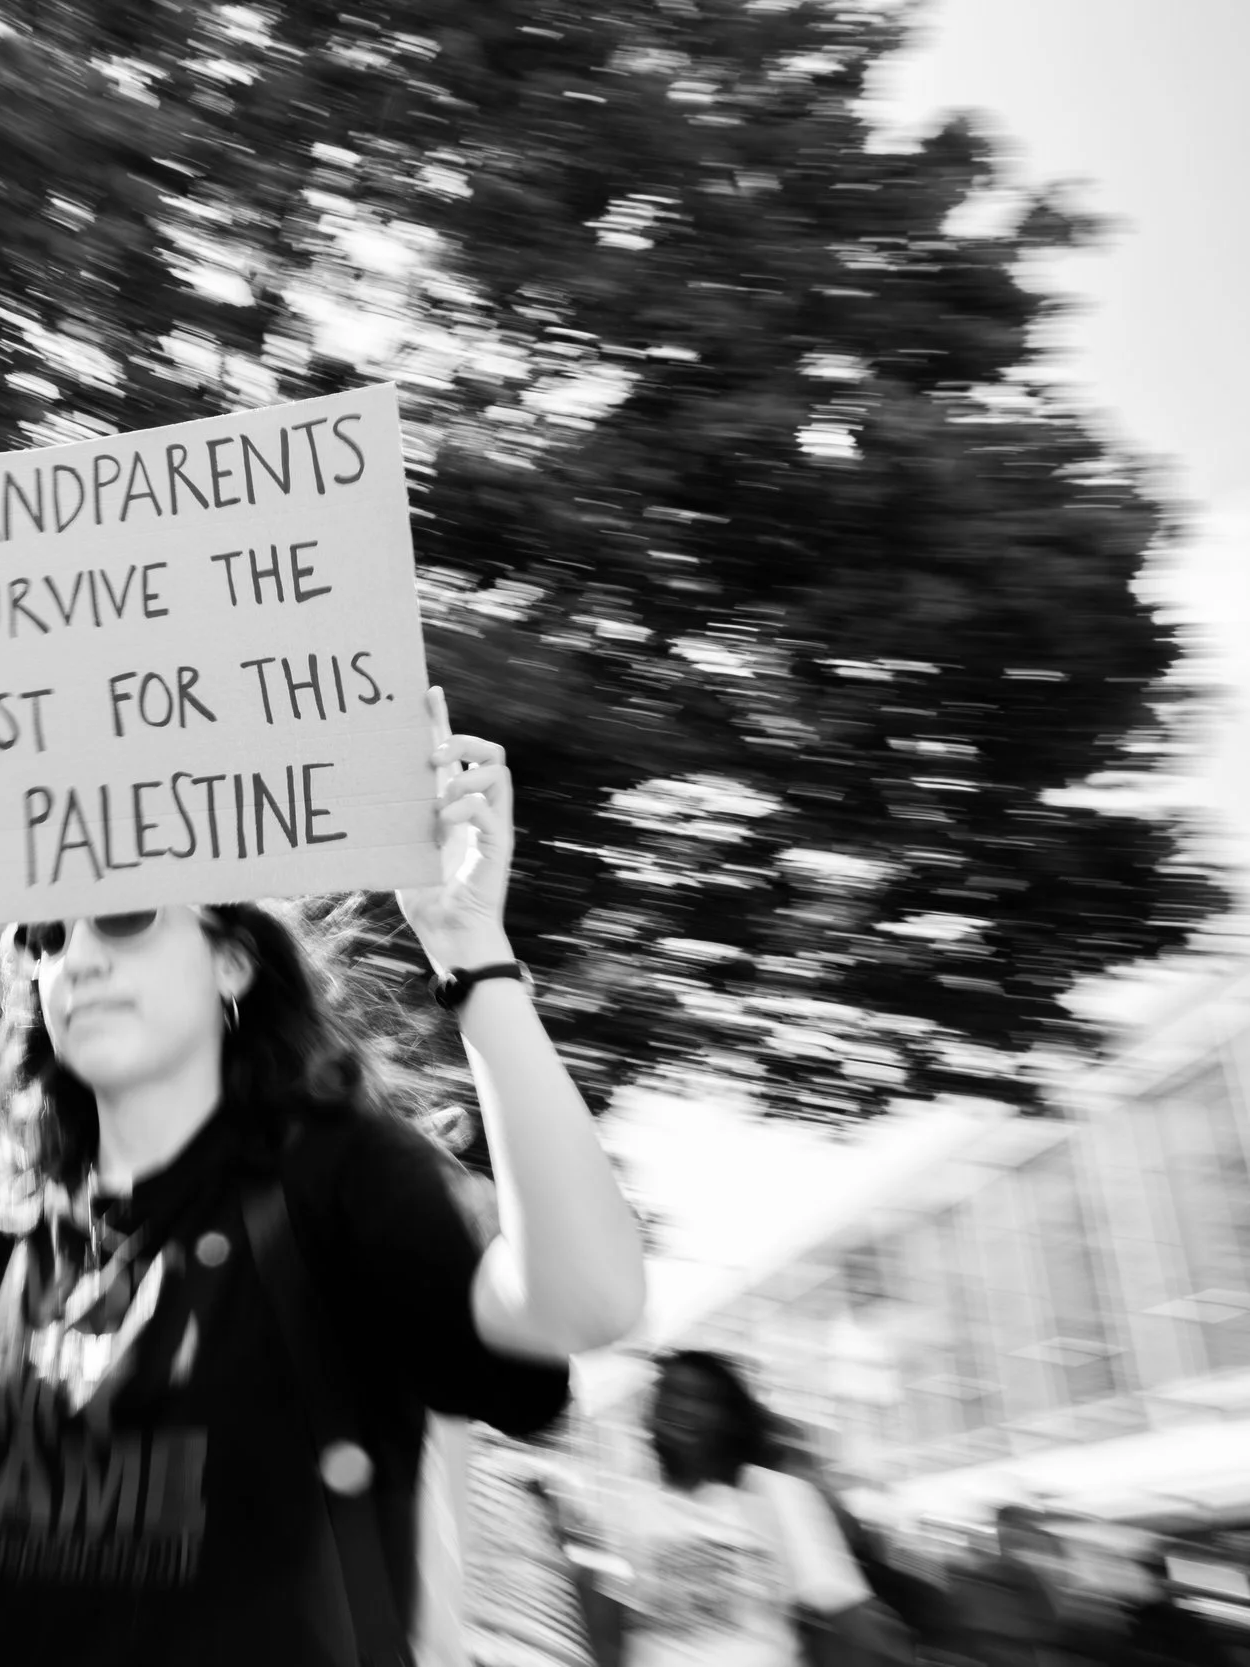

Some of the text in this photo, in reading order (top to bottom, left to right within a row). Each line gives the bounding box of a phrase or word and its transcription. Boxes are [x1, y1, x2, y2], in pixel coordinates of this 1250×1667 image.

[209, 539, 333, 607] THE
[106, 664, 217, 737] FOR
[240, 650, 394, 725] THIS.
[23, 761, 348, 888] PALESTINE
